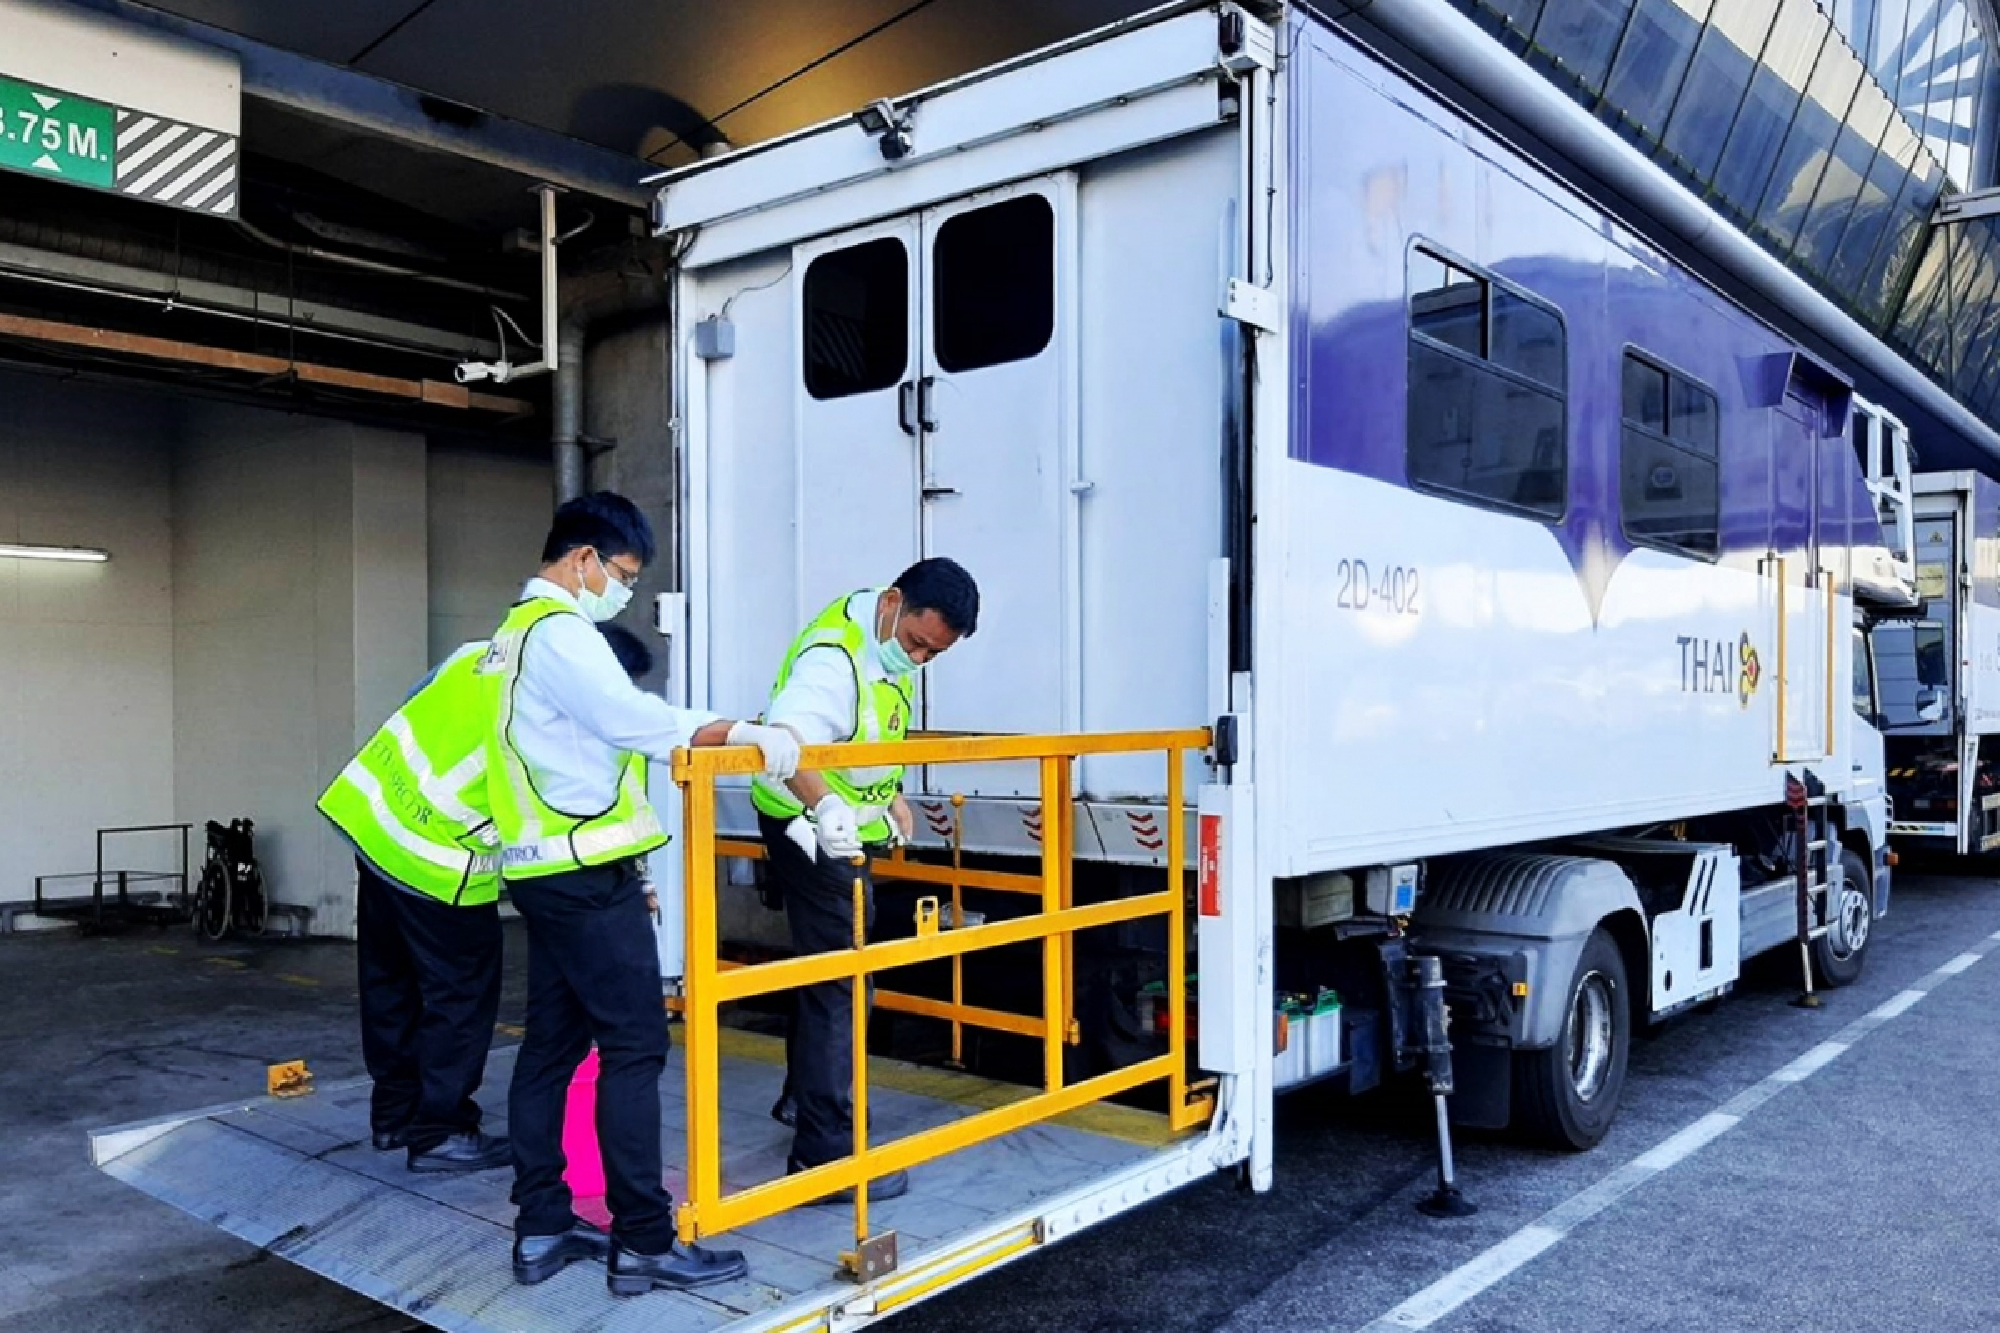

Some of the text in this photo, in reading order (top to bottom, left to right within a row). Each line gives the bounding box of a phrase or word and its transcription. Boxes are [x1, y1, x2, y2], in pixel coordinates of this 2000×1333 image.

[0, 106, 108, 163] .75M.
[1337, 557, 1419, 615] 2D-402
[1675, 634, 1733, 694] THAI
